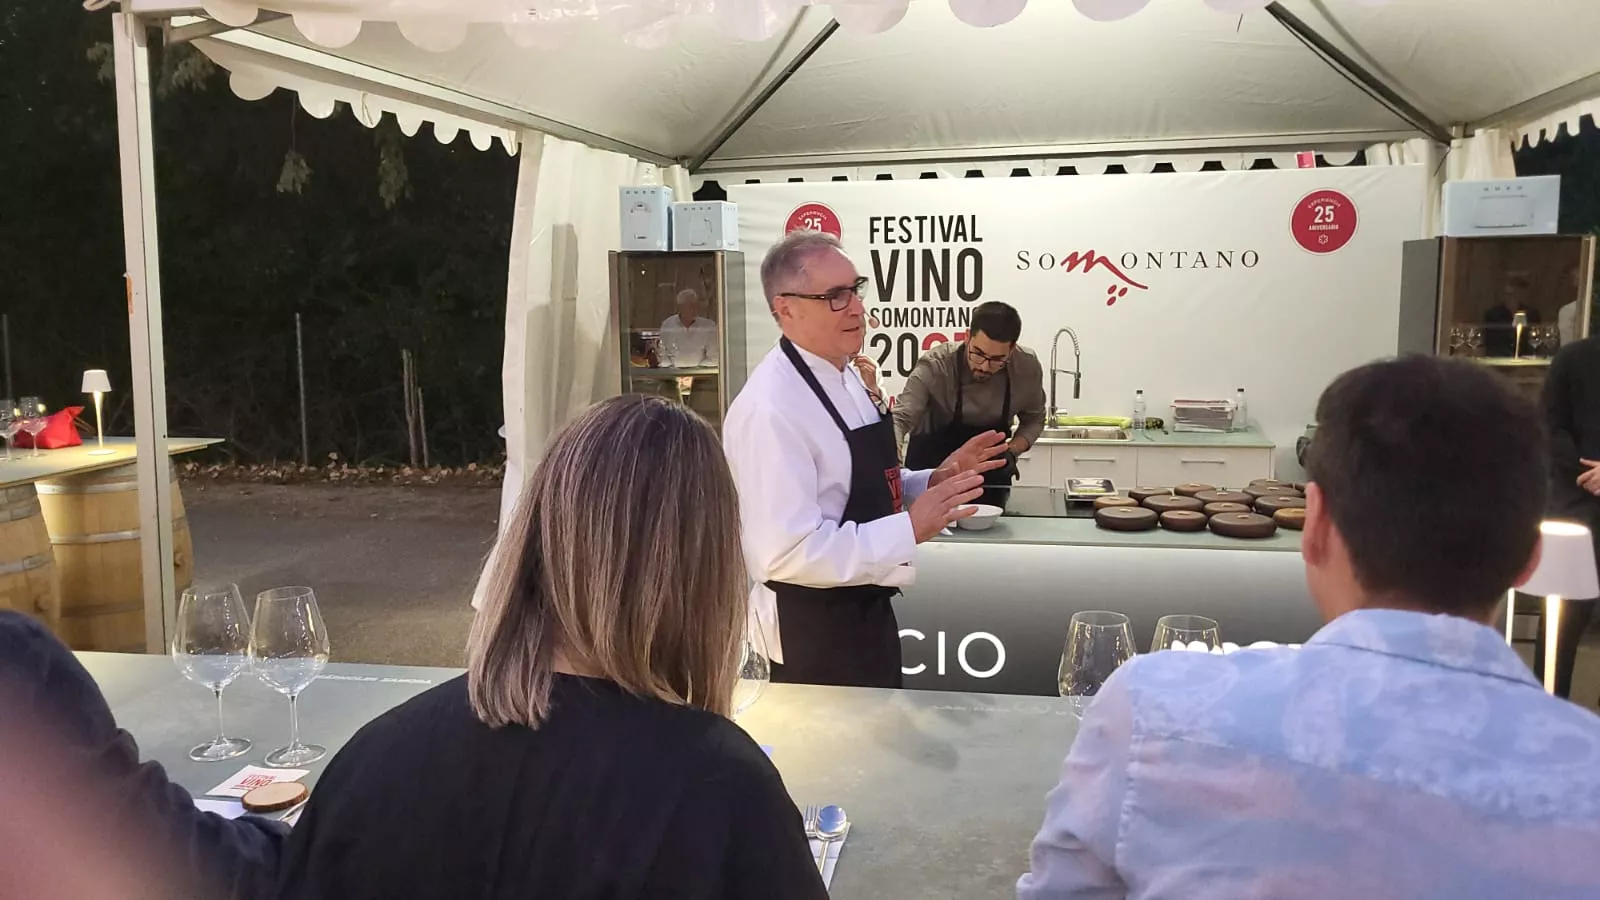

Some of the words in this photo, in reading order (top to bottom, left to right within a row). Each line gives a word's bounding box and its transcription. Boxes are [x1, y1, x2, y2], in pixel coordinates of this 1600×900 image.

[869, 214, 983, 244] FESTIVAL
[1313, 205, 1335, 223] 25
[870, 247, 983, 303] VINO
[1016, 249, 1260, 290] SOMONTANO
[870, 306, 978, 328] SOMONTAN
[870, 332, 968, 378] 20
